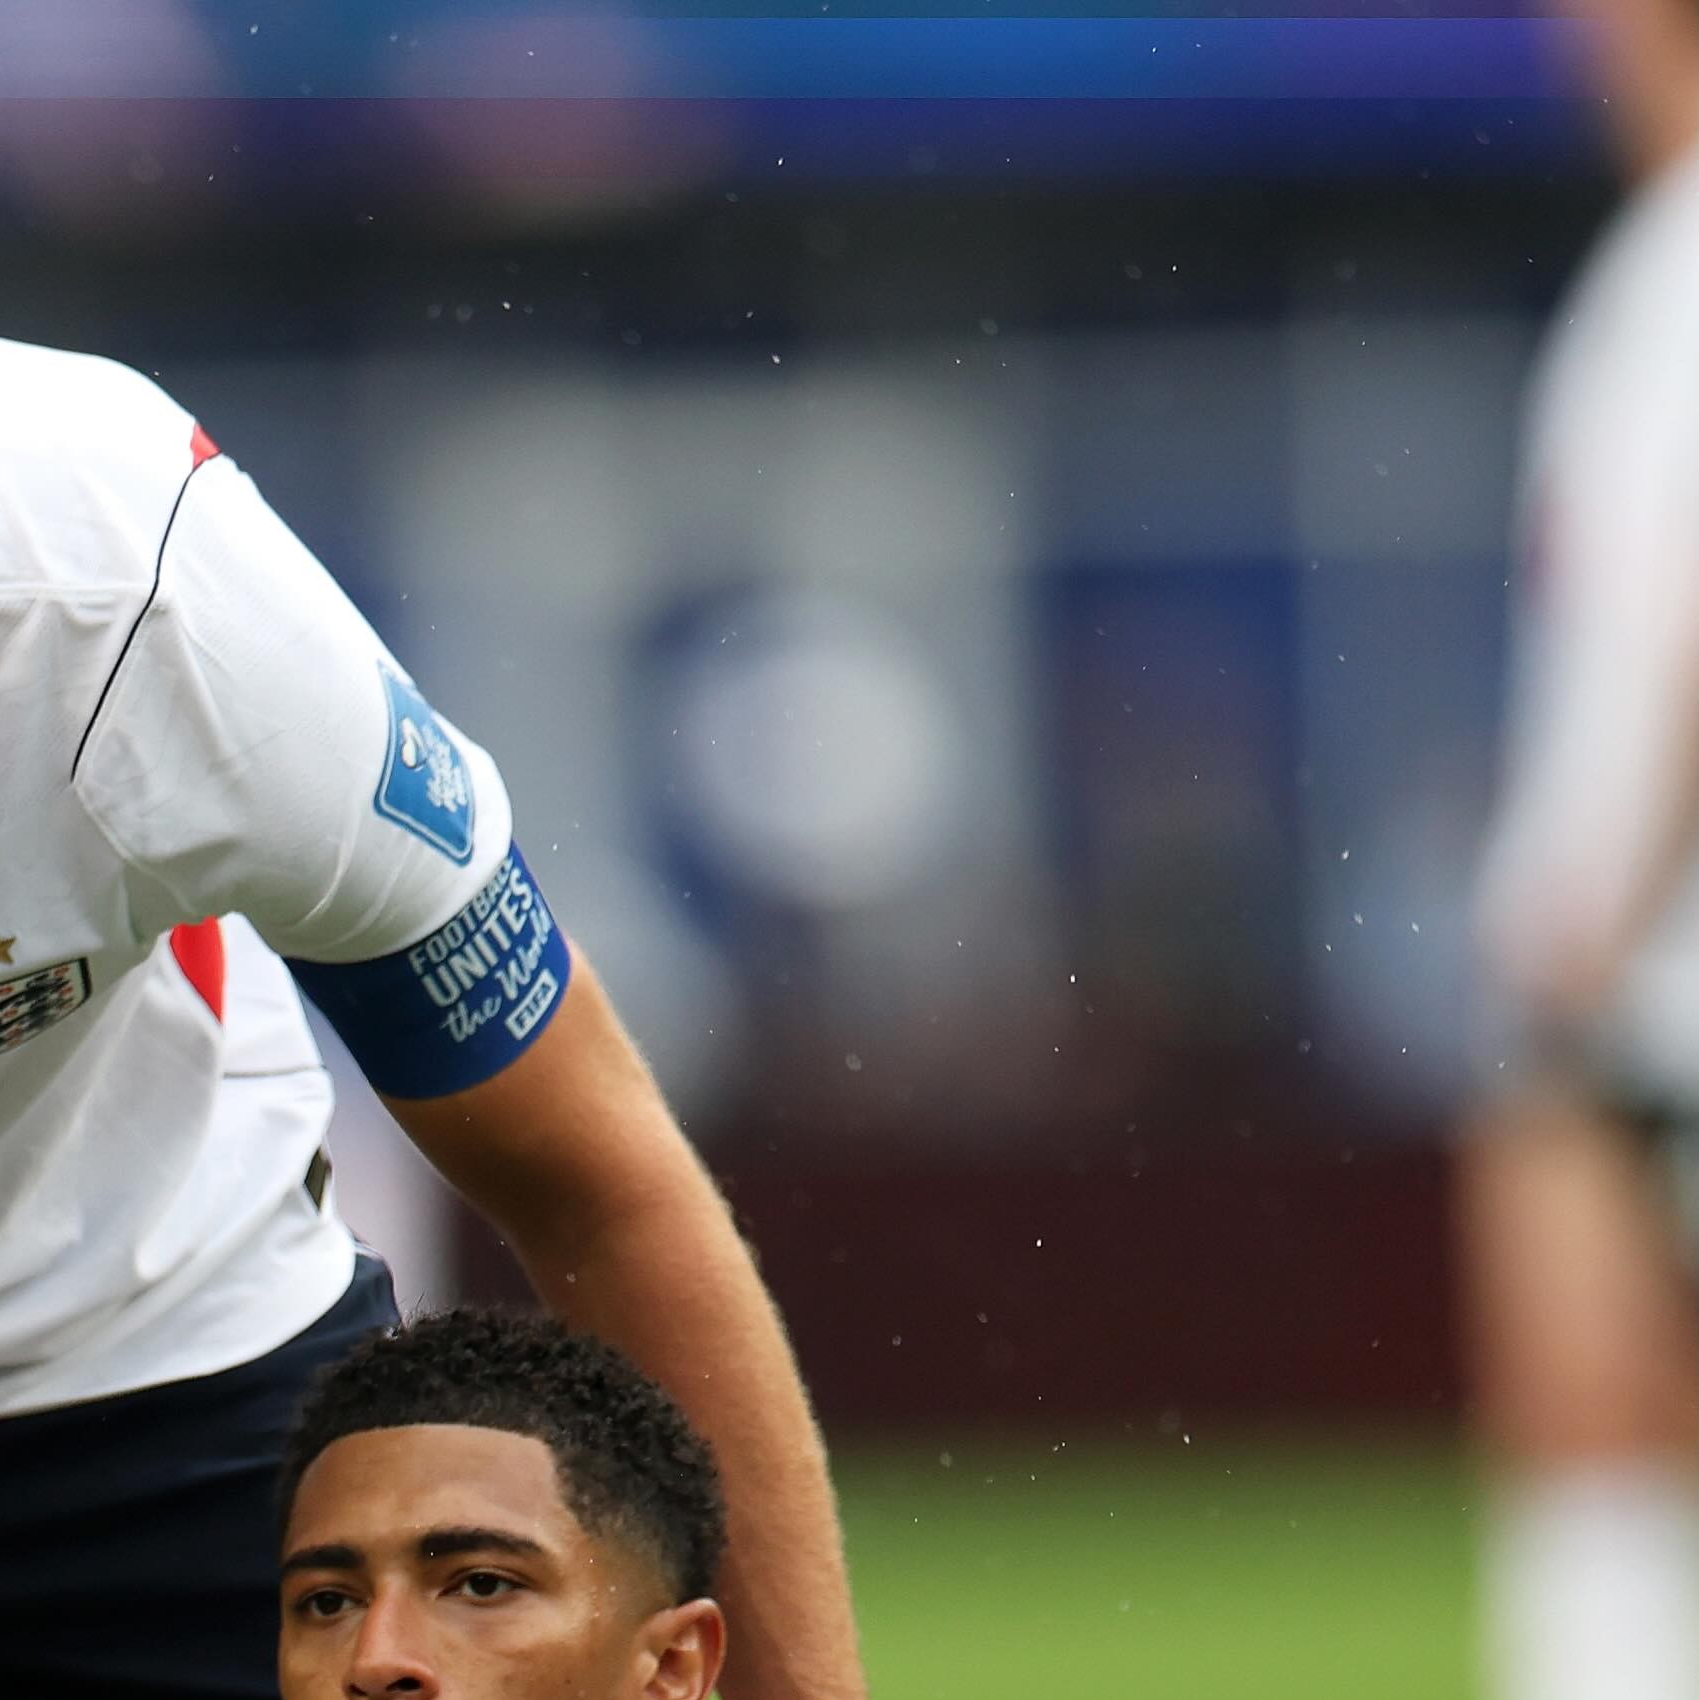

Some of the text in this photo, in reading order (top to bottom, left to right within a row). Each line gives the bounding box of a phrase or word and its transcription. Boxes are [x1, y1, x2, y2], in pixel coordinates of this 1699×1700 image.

[408, 856, 514, 976] FOOTBALL
[421, 866, 534, 1008] UNITES
[439, 890, 552, 1043] the World
[511, 978, 554, 1033] FIFA
